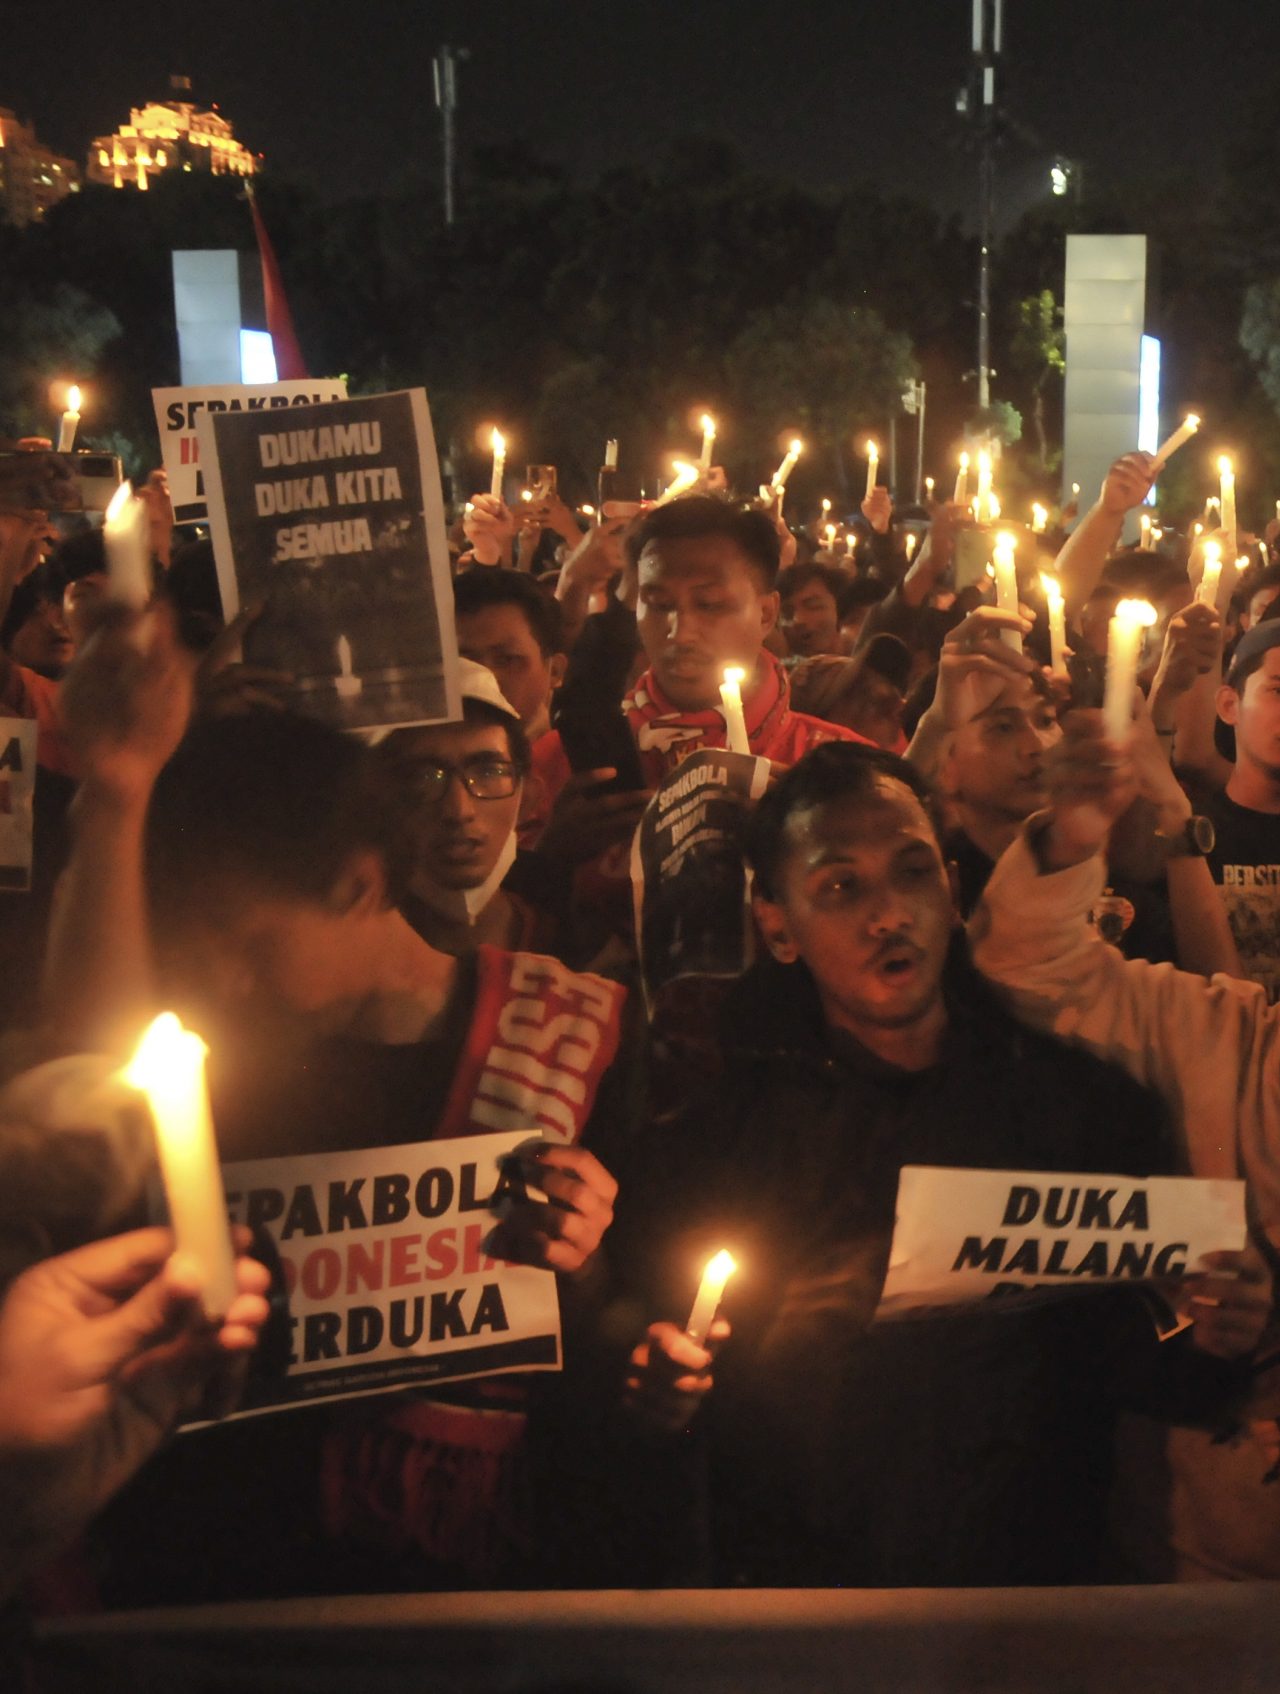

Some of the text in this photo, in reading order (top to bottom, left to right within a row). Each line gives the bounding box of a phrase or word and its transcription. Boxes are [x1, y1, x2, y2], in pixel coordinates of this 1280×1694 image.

[259, 421, 382, 468] DUKAMU
[255, 472, 330, 517] DUKA
[336, 467, 402, 505] KITA
[275, 518, 373, 561] SEMUA
[226, 1163, 529, 1241] PAKBOLA
[1001, 1186, 1149, 1231] DUKA
[283, 1224, 524, 1301] ONESI
[951, 1236, 1189, 1277] MALANG
[289, 1283, 509, 1366] RDUKA
